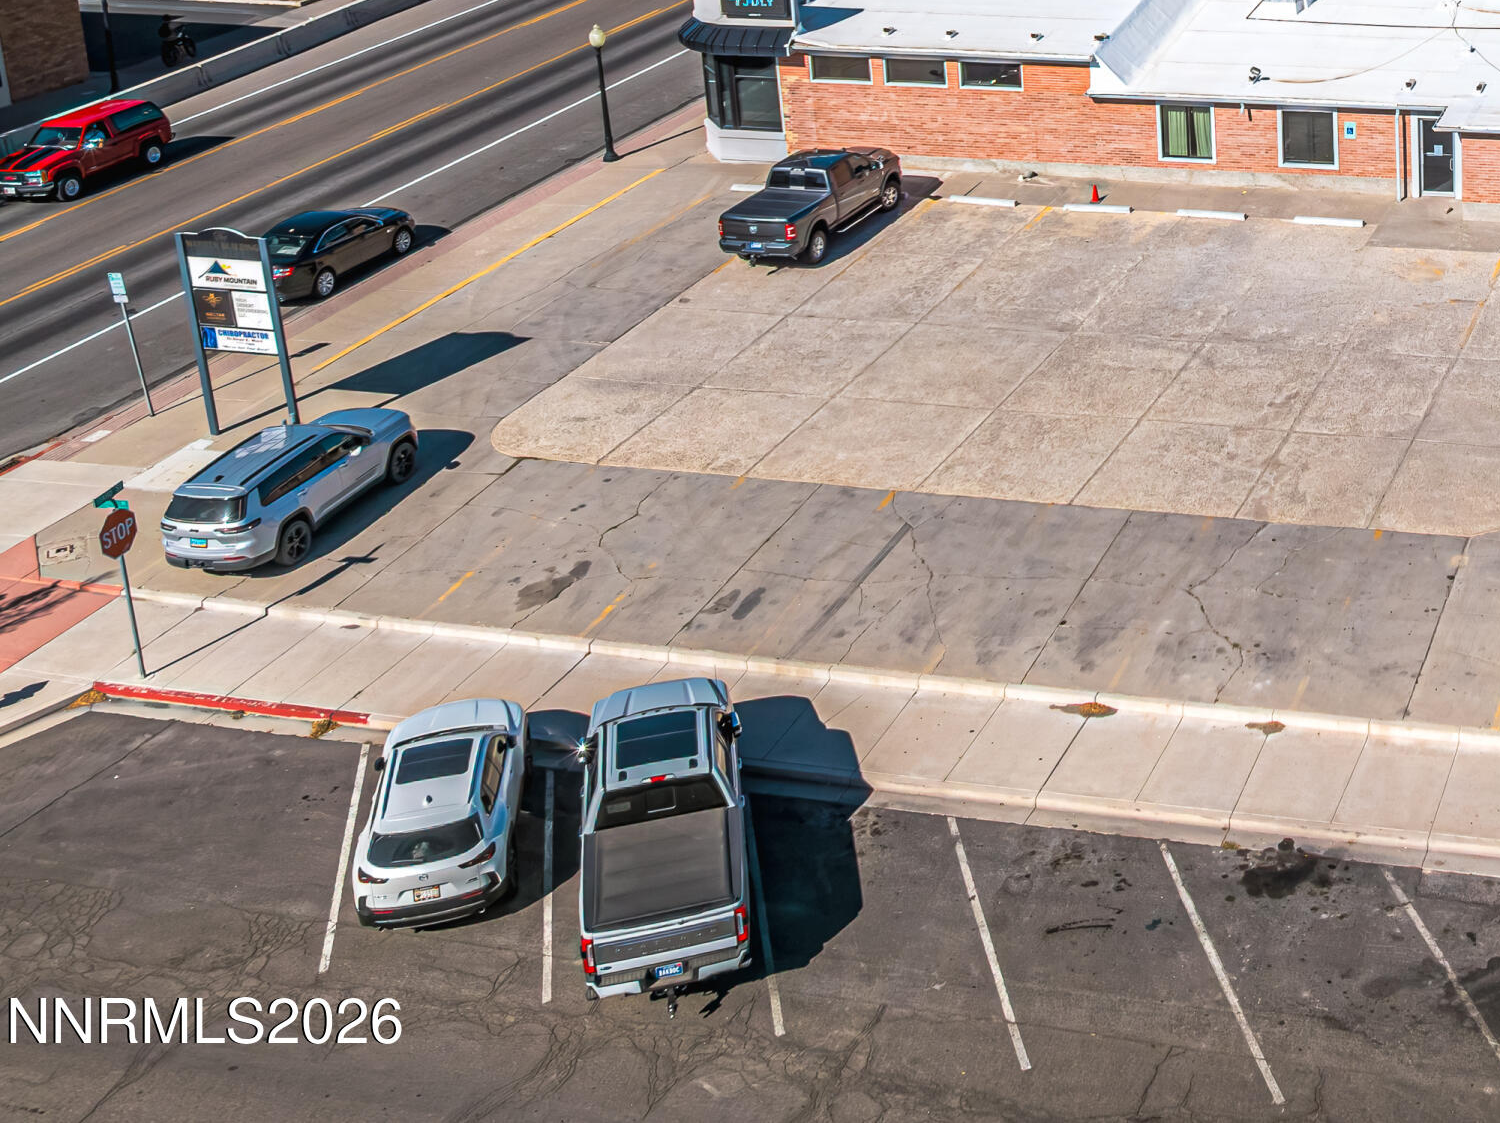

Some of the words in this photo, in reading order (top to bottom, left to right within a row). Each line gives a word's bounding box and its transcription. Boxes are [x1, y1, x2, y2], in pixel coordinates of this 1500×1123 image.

[206, 275, 223, 283] RUBY
[223, 277, 257, 285] MOUNTAIN
[218, 329, 269, 339] CHIROPRACTOR
[103, 517, 133, 549] STOP
